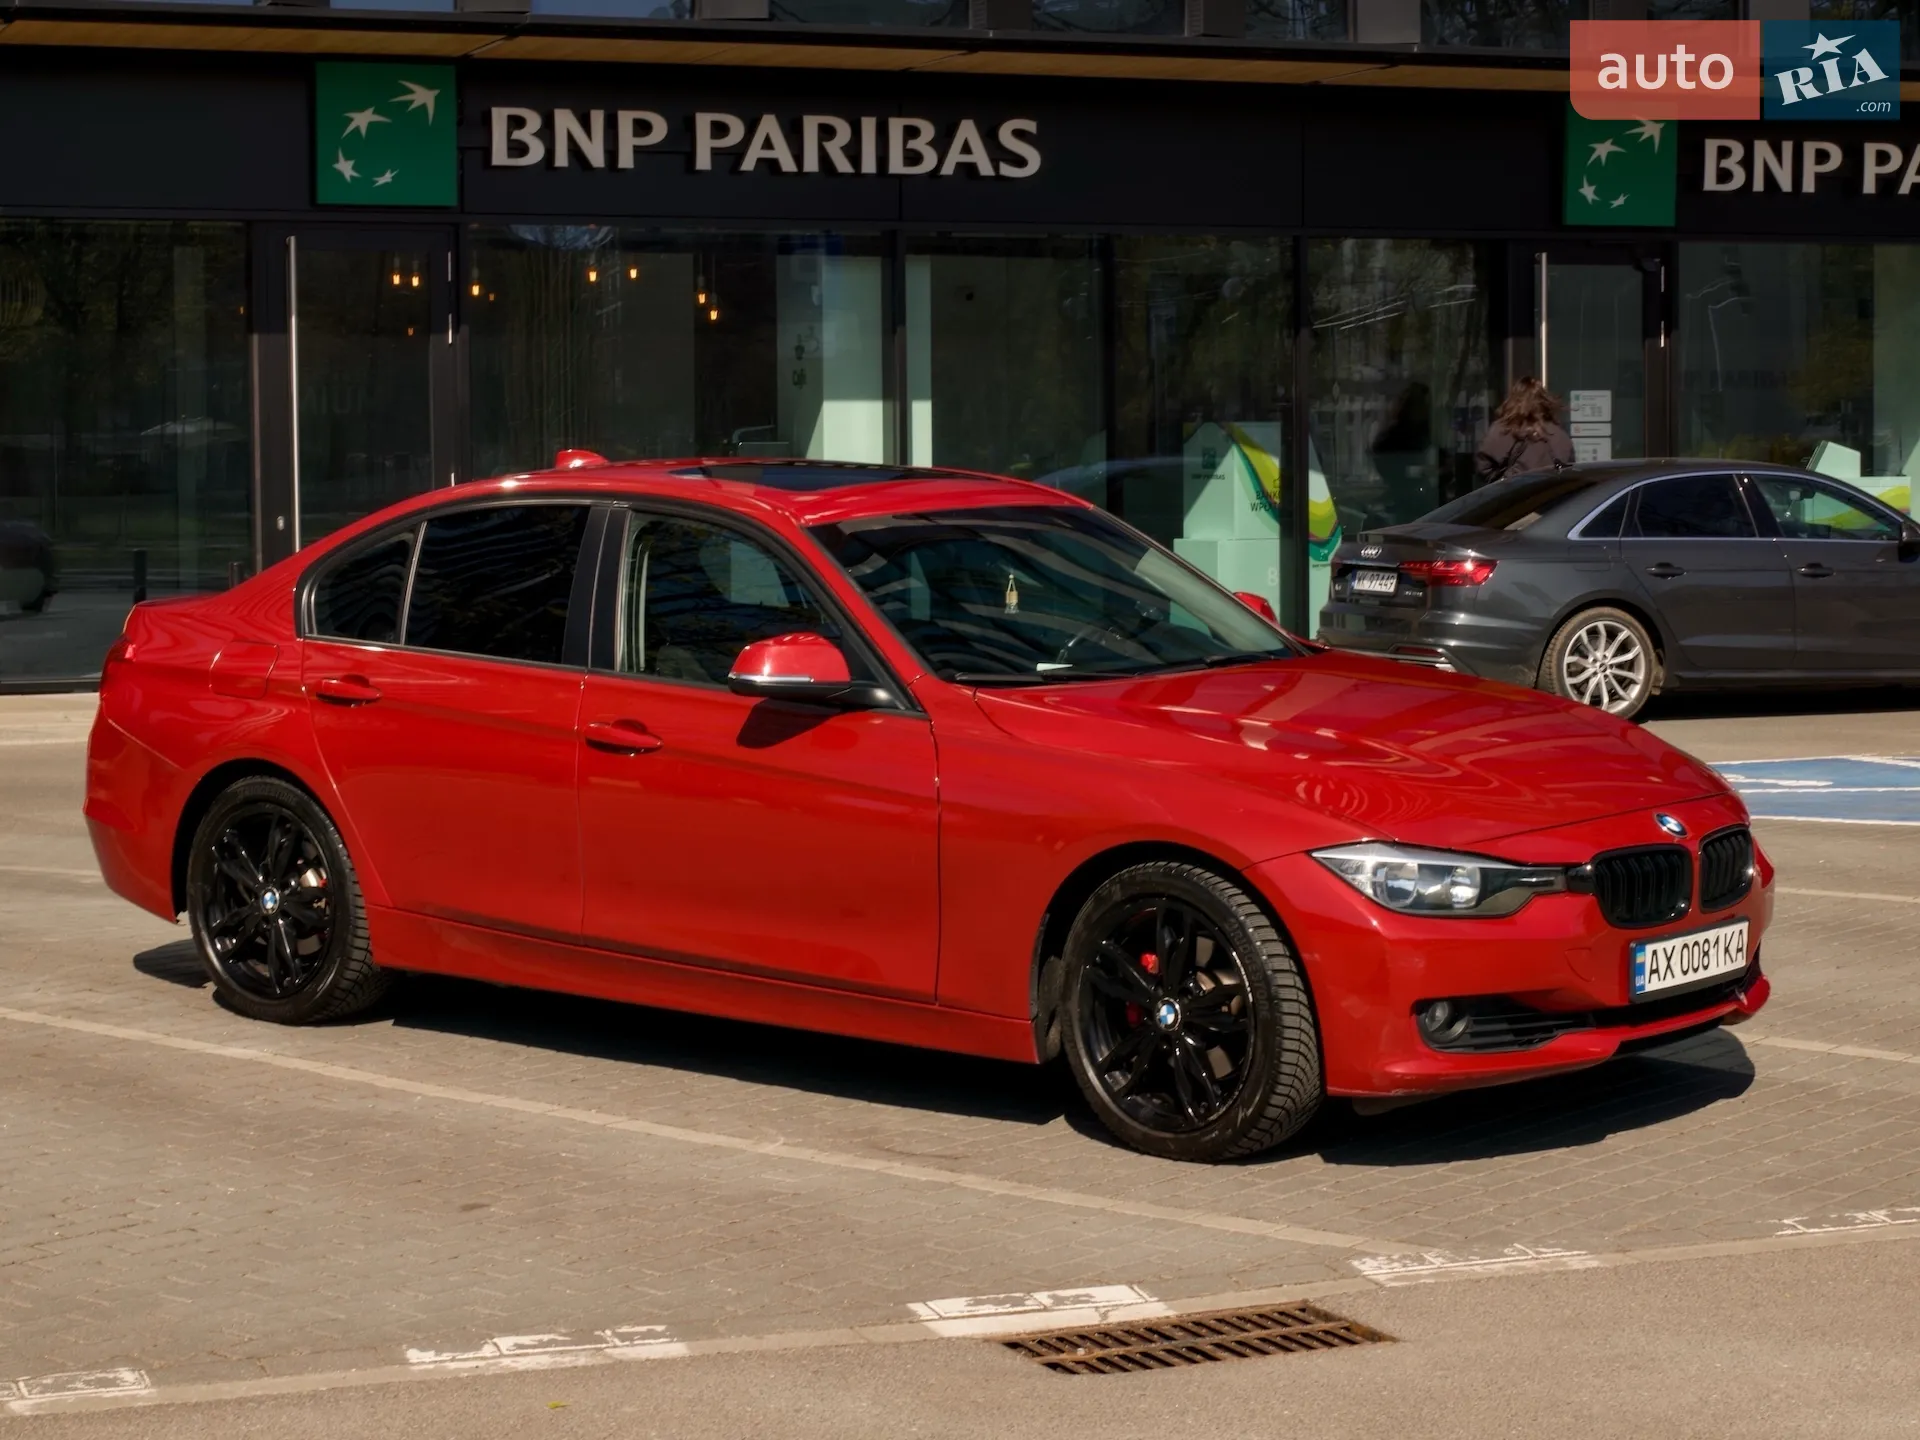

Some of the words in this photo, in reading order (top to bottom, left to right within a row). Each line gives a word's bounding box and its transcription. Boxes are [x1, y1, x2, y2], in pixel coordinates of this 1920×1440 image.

[491, 107, 668, 168] BNP
[695, 112, 1041, 178] PARIBAS
[1703, 138, 1843, 194] BNP
[1648, 944, 1676, 984] AX
[1680, 934, 1720, 976] 0081
[1723, 928, 1745, 967] KA
